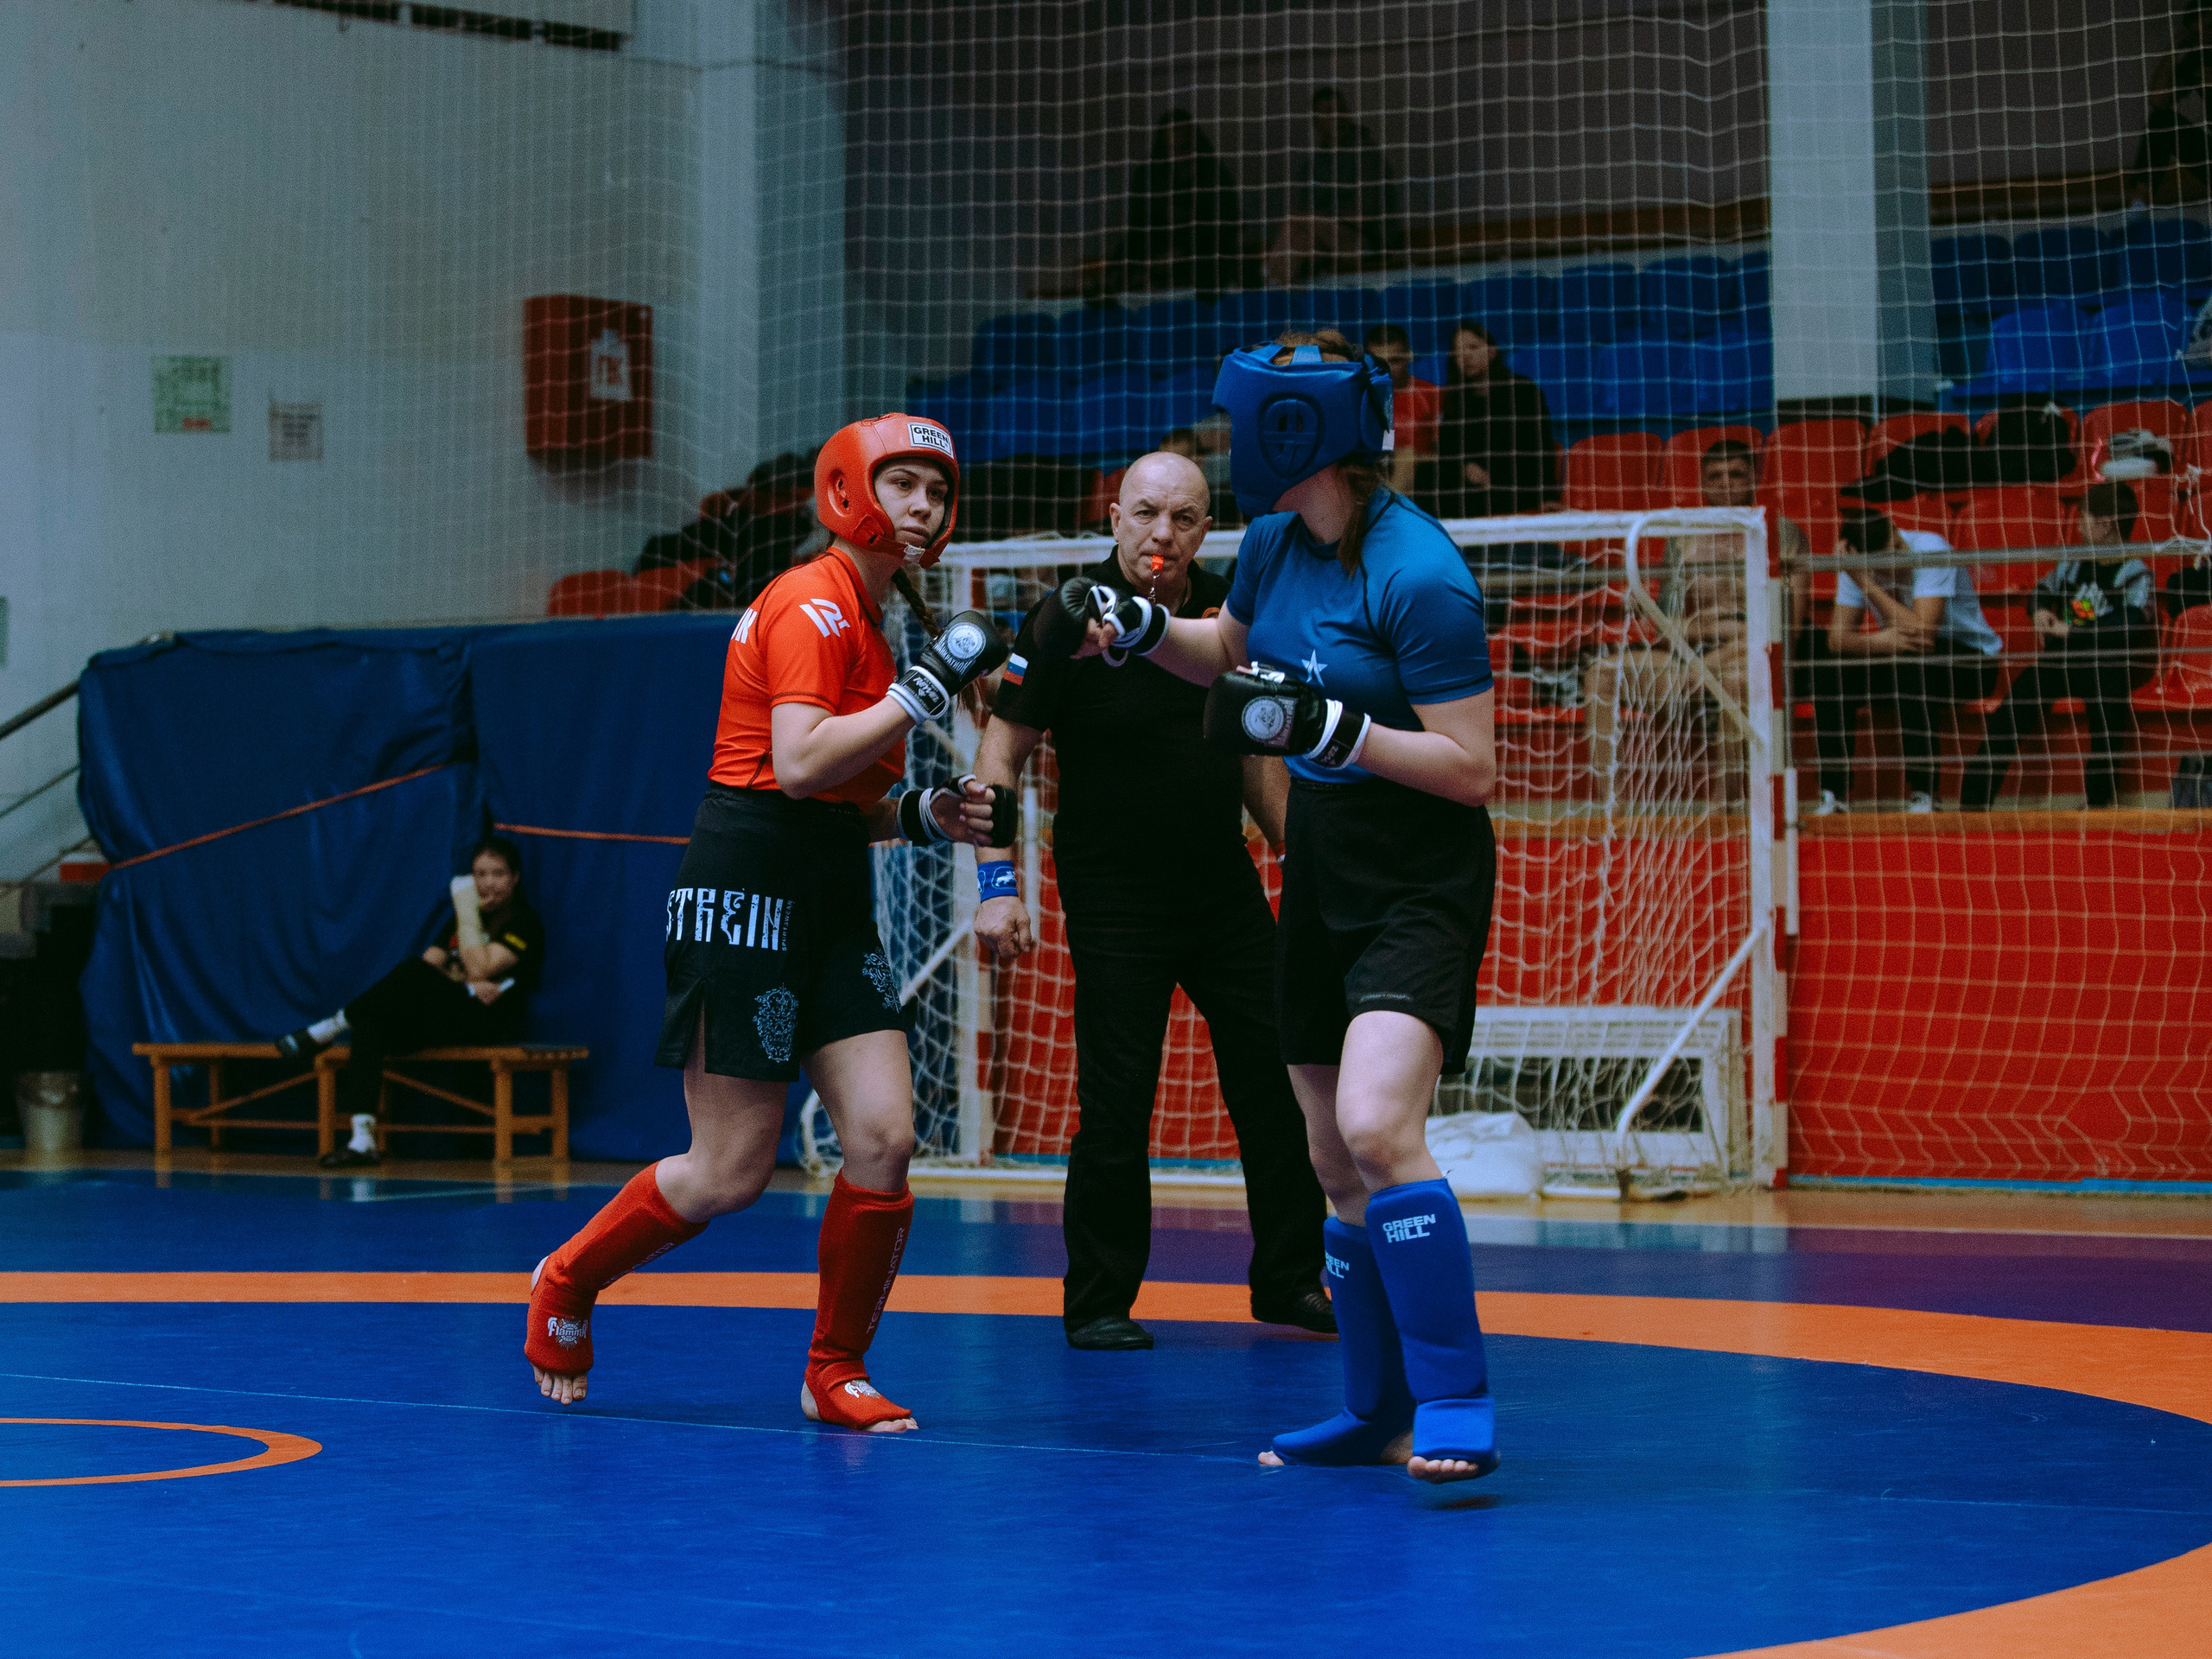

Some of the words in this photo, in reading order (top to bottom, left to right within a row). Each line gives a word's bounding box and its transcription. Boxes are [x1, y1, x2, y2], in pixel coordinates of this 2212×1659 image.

[913, 427, 949, 443] GREEN
[922, 435, 945, 448] HILL
[1382, 1214, 1436, 1232] GREEN
[1386, 1225, 1430, 1243] HILL
[866, 1227, 906, 1334] TERMINATOR
